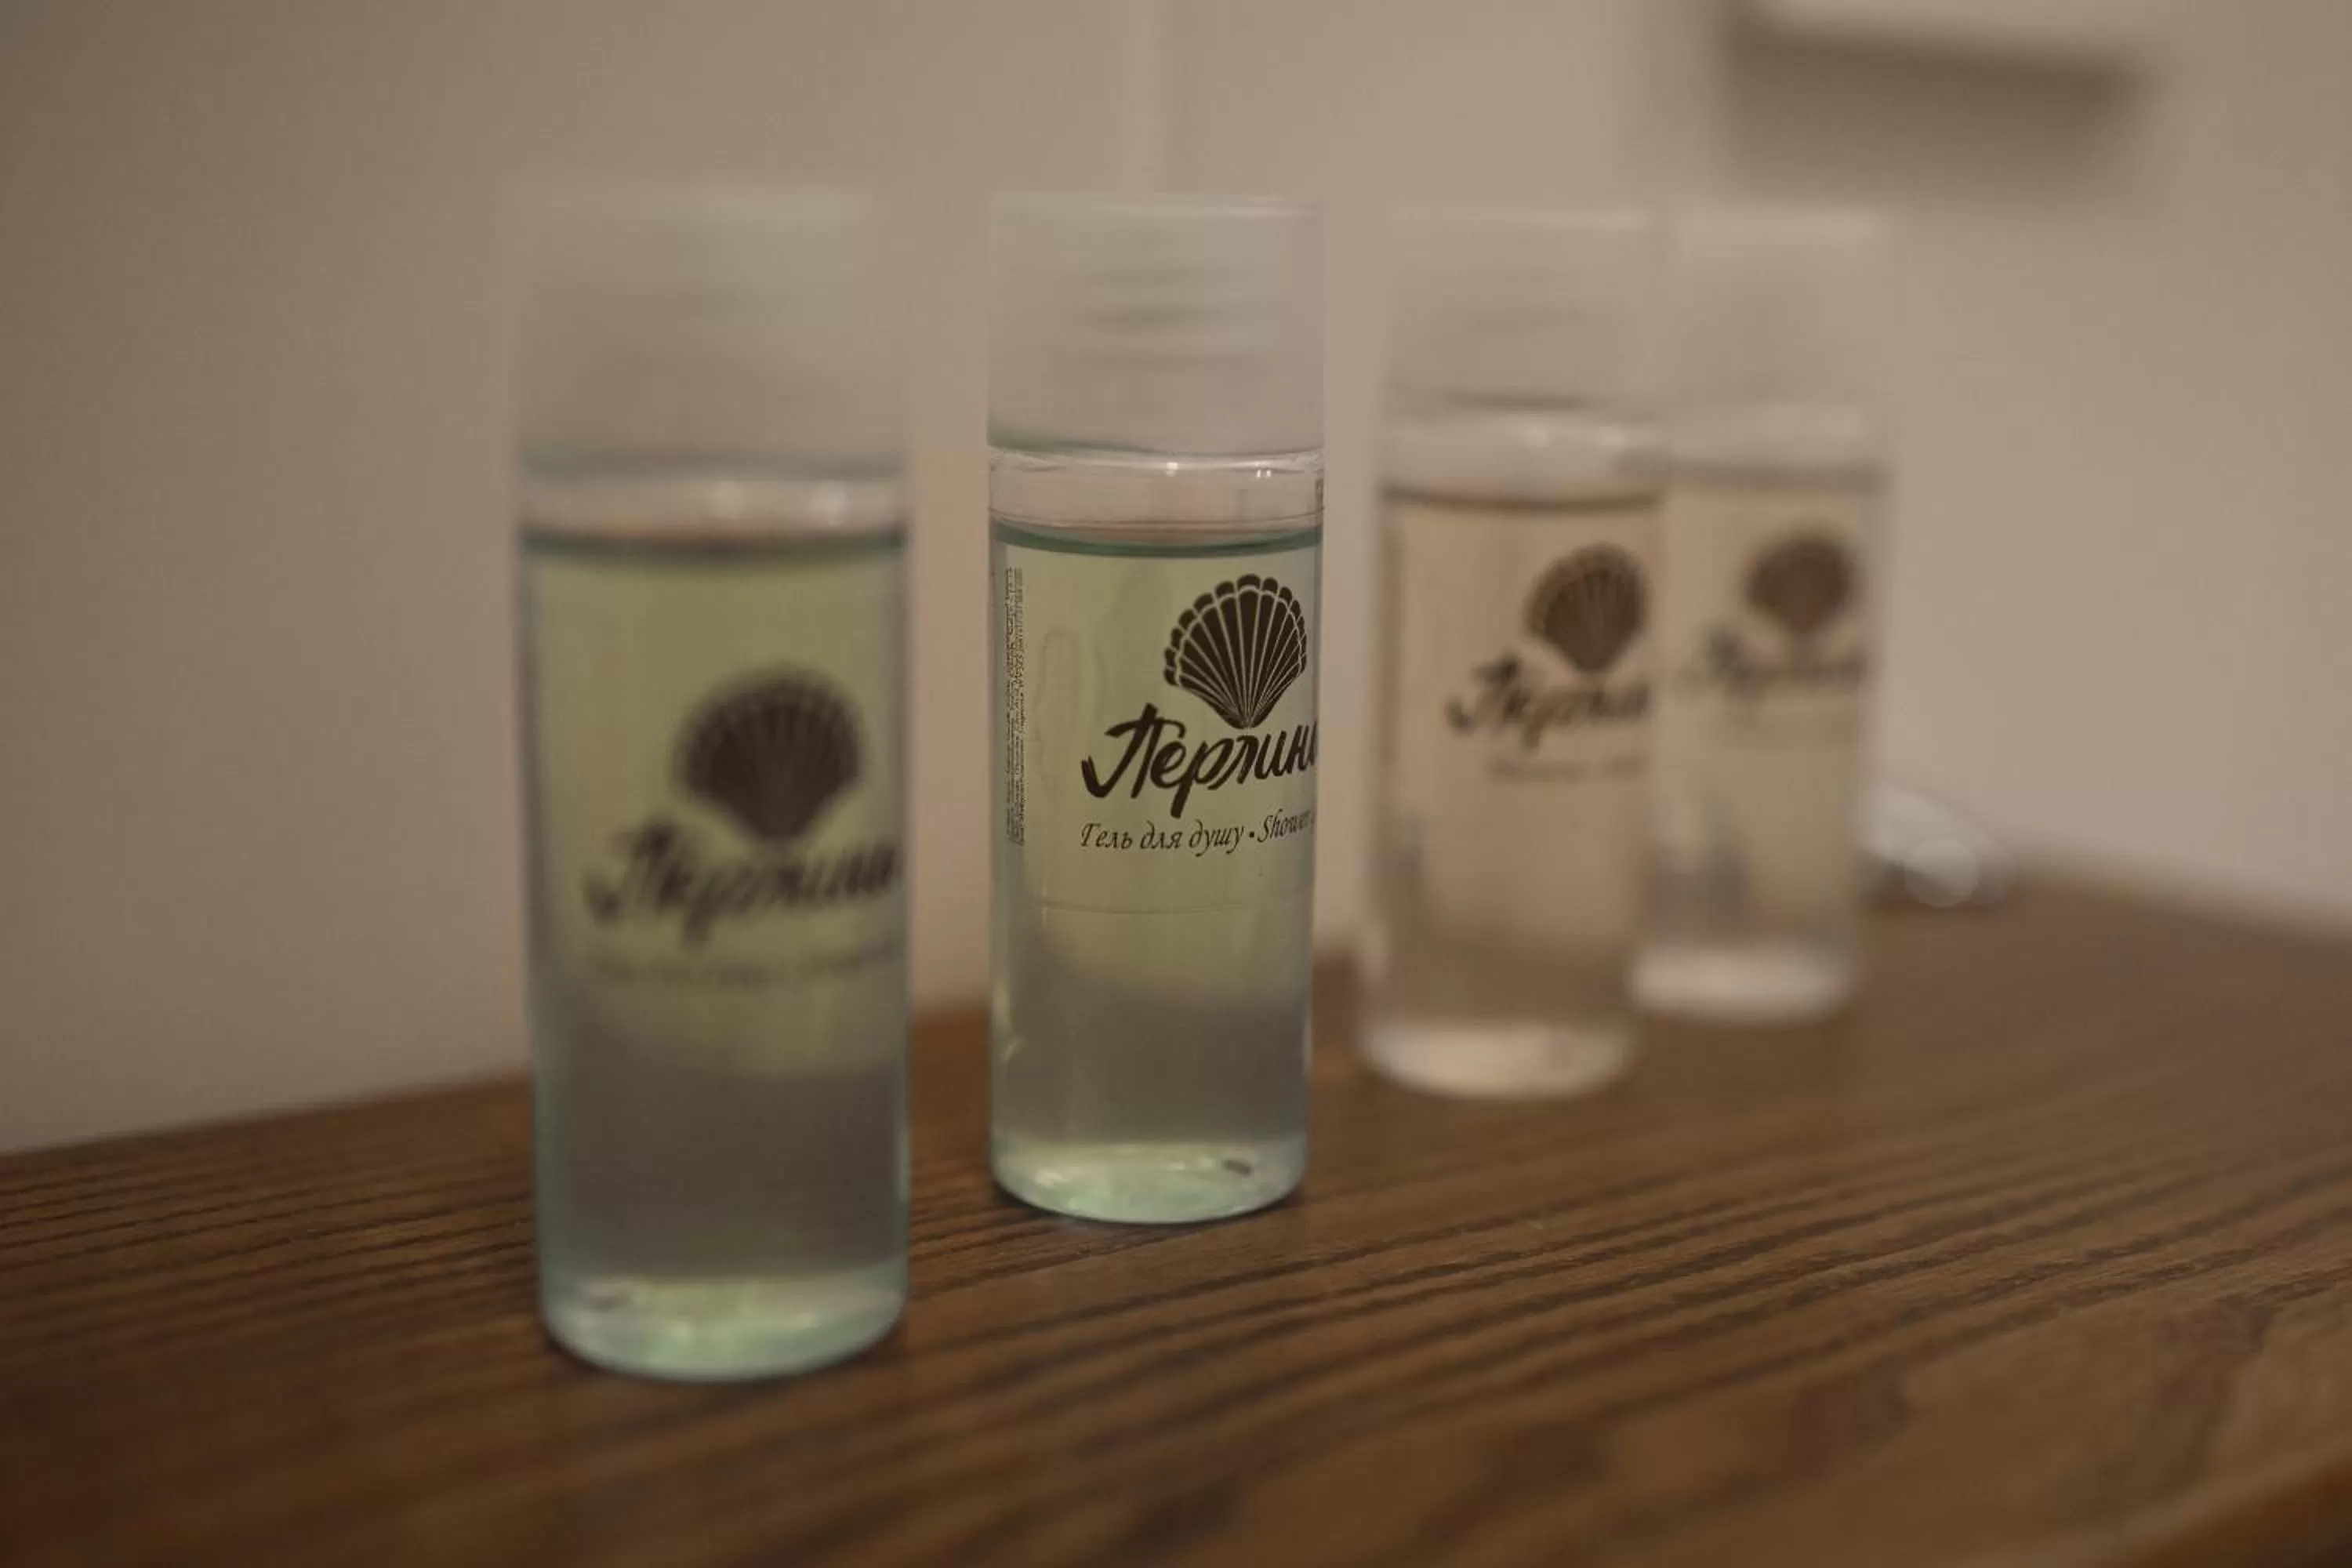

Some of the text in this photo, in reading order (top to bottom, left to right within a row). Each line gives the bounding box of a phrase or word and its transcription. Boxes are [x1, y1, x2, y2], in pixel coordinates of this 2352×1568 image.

[1080, 822, 1133, 850] Гель
[1139, 820, 1182, 850] для
[1188, 818, 1244, 857] душу
